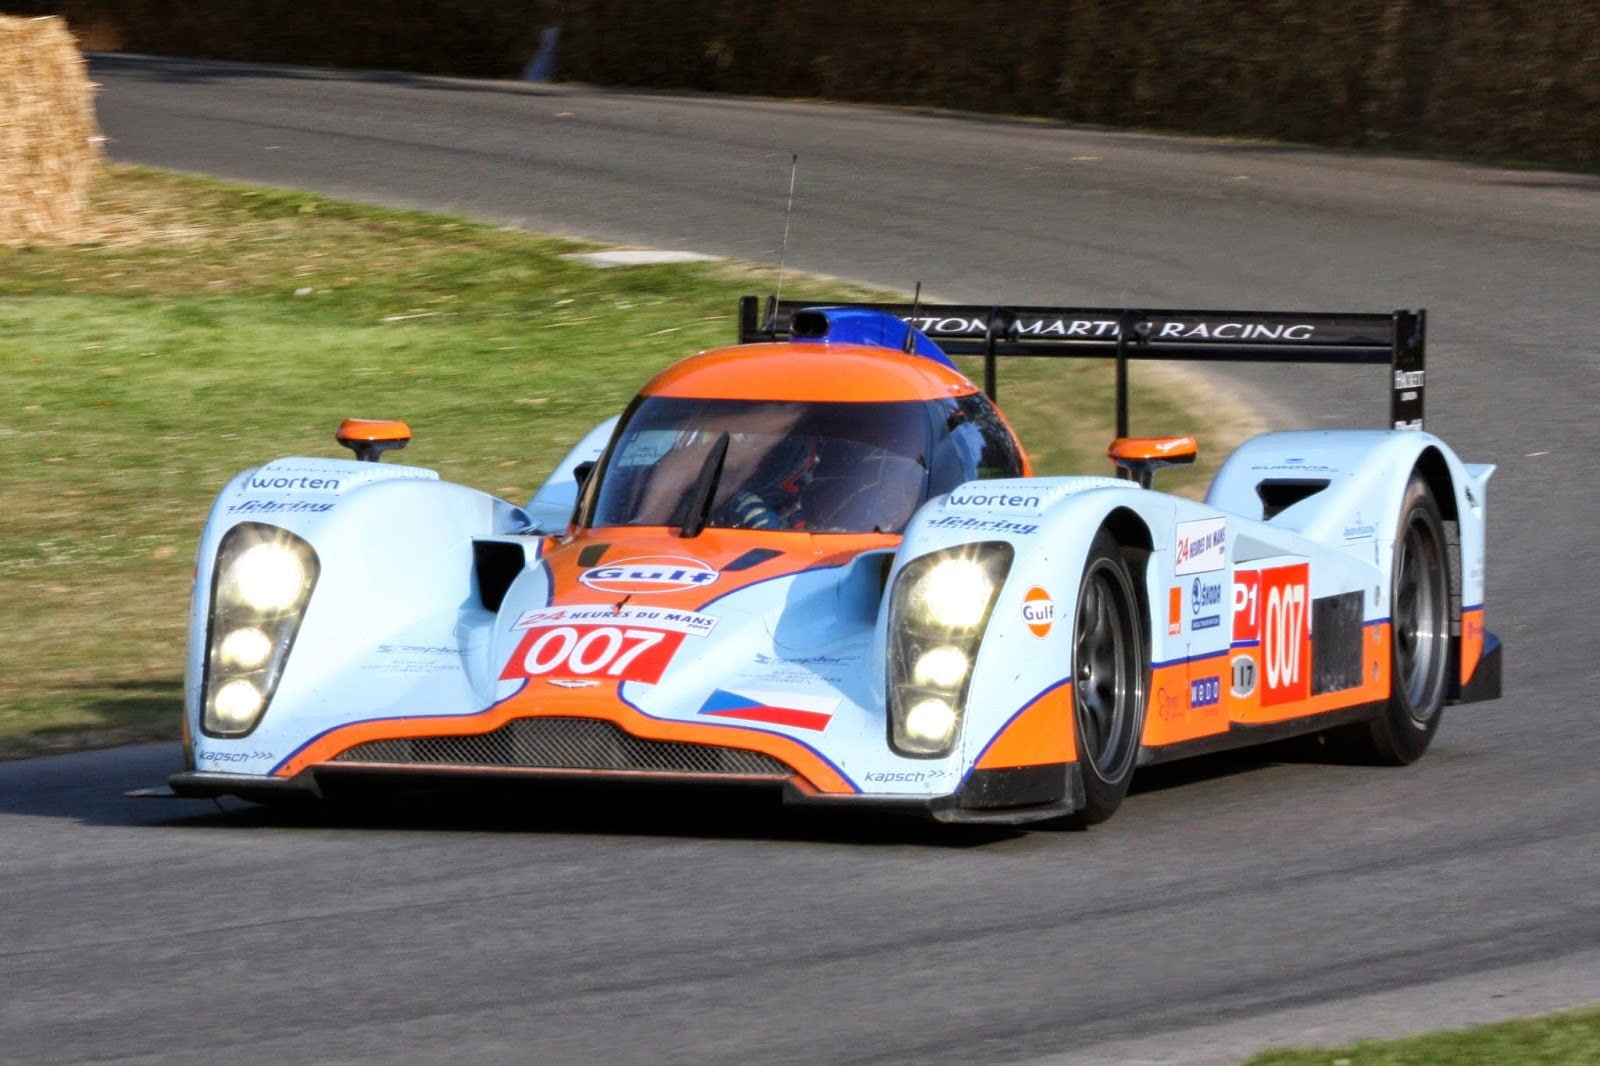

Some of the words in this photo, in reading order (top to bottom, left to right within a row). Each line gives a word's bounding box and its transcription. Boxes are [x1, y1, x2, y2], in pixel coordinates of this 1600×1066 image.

[1010, 319, 1153, 336] MARTI
[1160, 321, 1315, 341] RACING
[251, 475, 340, 490] worten
[227, 500, 336, 513] Sebring
[950, 494, 1040, 508] worten
[927, 516, 1040, 535] Sebring
[1176, 536, 1189, 565] 24
[584, 567, 716, 585] Gulf
[1023, 605, 1054, 621] Gulf
[1233, 583, 1258, 626] P1
[519, 611, 567, 626] 24
[635, 611, 661, 620] DU
[663, 613, 715, 627] MANS
[1265, 584, 1305, 690] 007
[524, 626, 666, 675] 007
[200, 750, 250, 763] kapsch
[864, 770, 926, 784] kapsch
